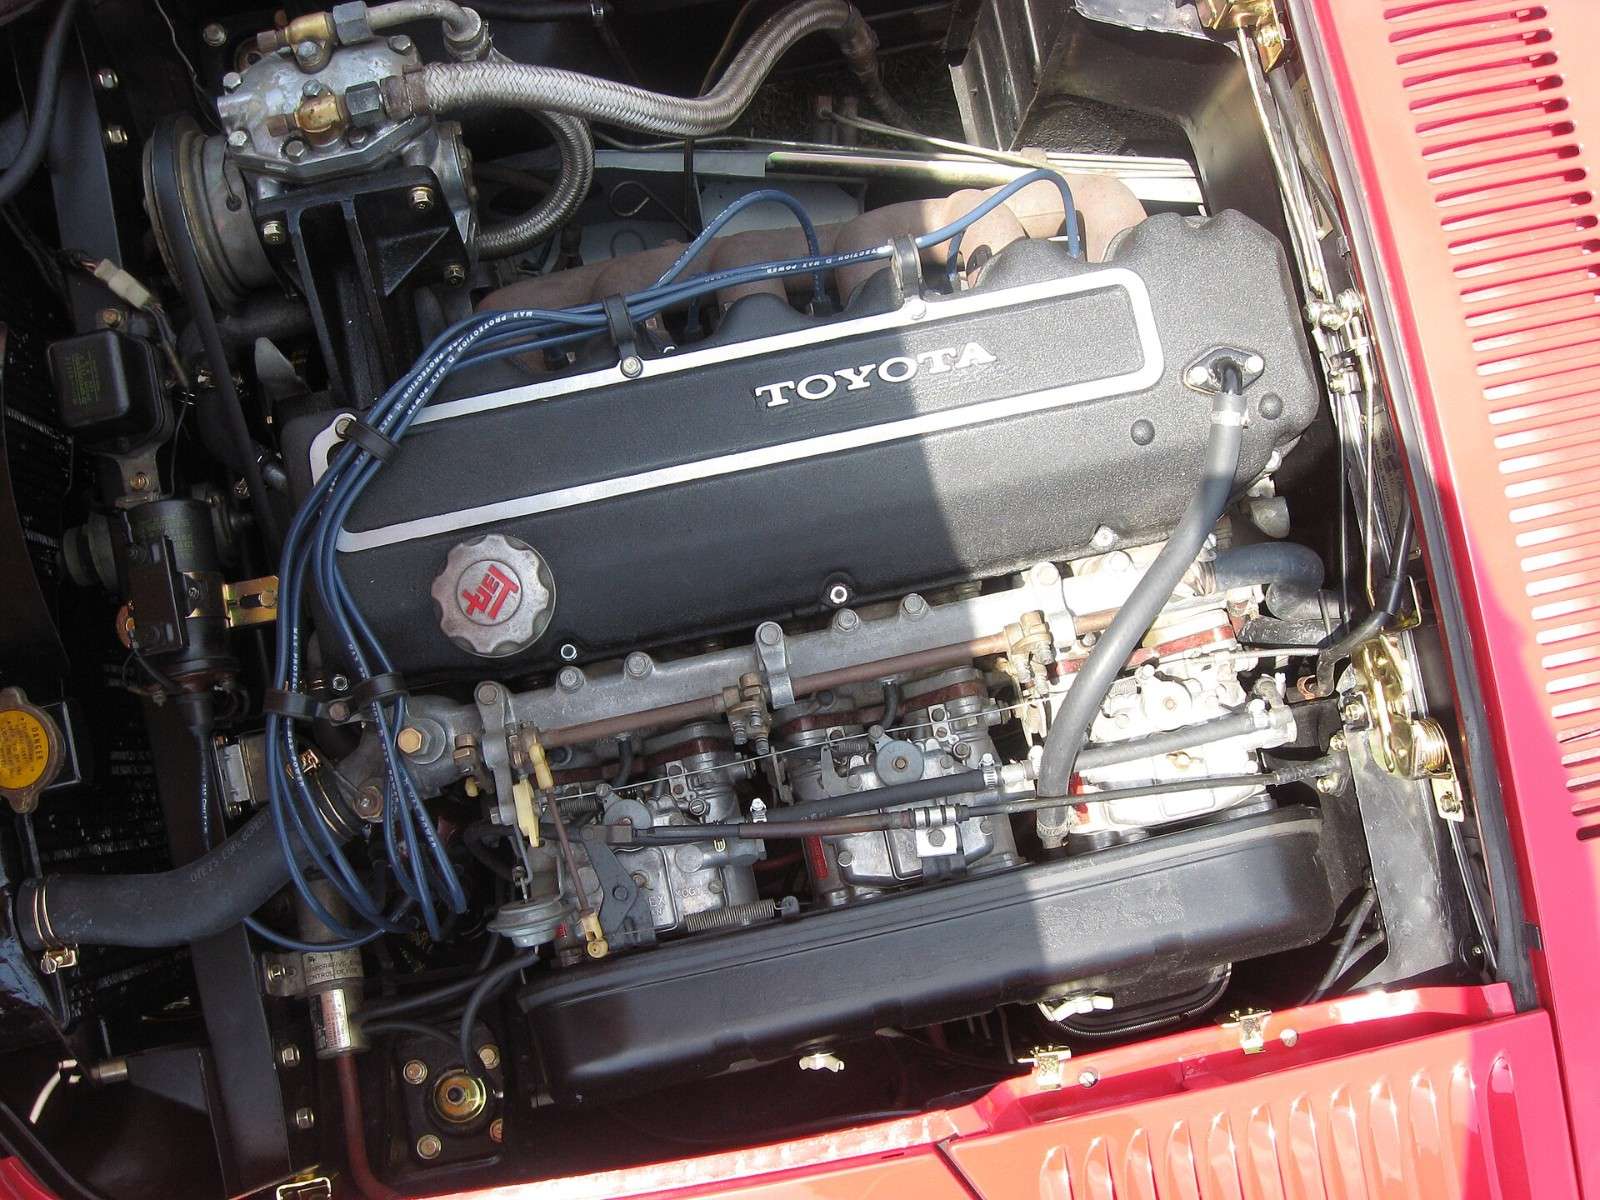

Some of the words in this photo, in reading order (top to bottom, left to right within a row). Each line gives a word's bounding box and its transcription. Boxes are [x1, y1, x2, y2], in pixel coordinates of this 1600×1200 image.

[513, 311, 533, 319] MAX
[457, 315, 507, 353] PROTECTION
[403, 353, 445, 399] PROTECTION
[430, 366, 446, 384] MAX
[755, 341, 997, 407] TOYOTA
[407, 387, 429, 416] POWER
